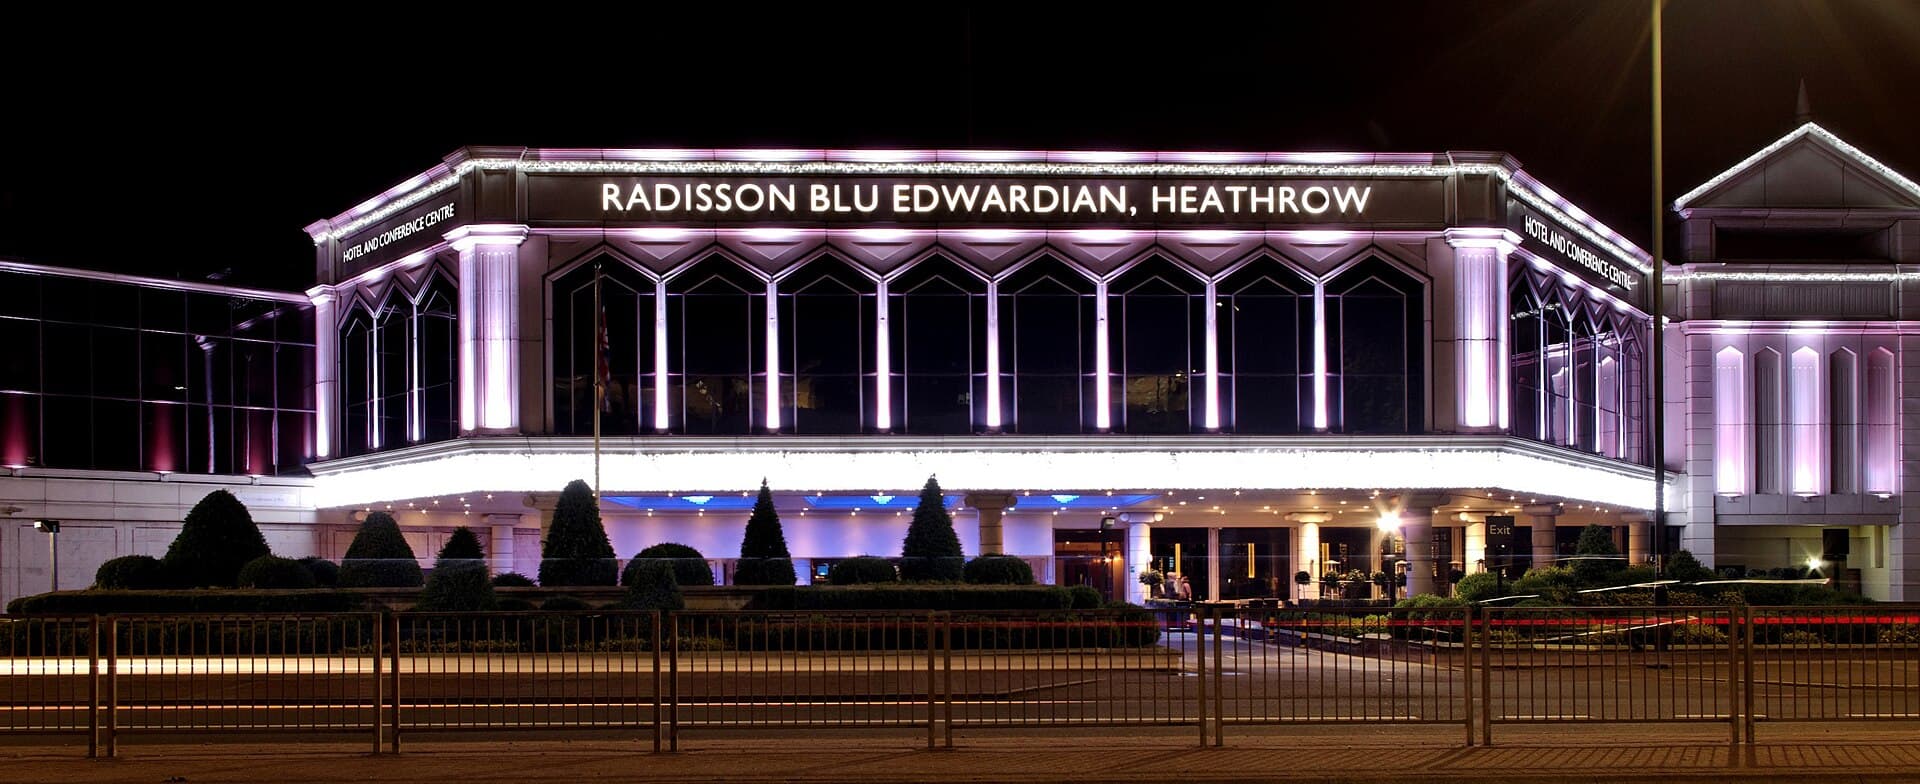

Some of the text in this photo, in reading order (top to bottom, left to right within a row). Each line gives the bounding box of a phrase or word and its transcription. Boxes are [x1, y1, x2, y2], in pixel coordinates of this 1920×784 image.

[601, 182, 1372, 216] RADISSON BLU EDWARDIAN, HEATHROW
[343, 202, 455, 263] HOTEL AND CONFERENCE CENTRE
[1524, 215, 1633, 291] HOTEL AND CONFERENCE CENTRE
[1489, 524, 1512, 536] Exit
